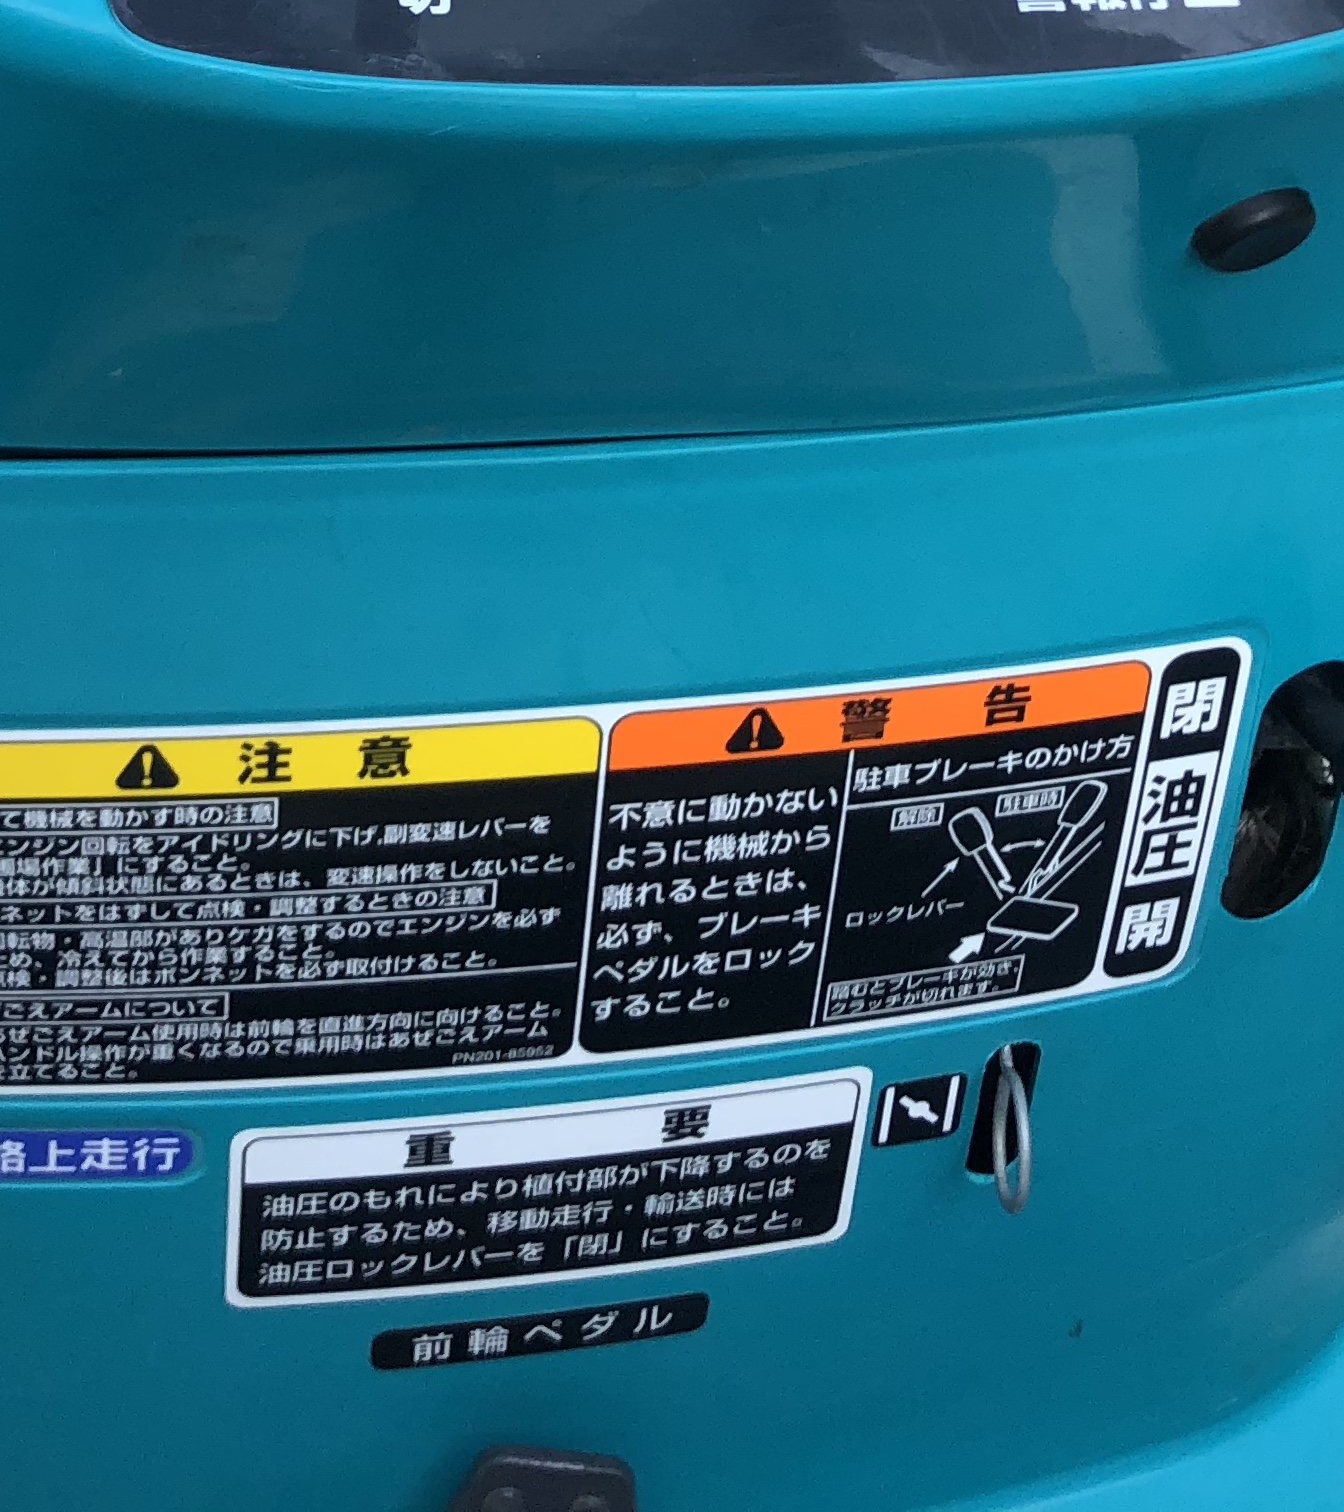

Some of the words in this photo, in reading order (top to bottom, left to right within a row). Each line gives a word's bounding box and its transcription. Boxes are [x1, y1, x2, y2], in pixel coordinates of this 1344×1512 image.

[1160, 676, 1227, 739] 閉
[852, 734, 1136, 792] 駐車ブレーキのかけ方
[609, 787, 839, 832] 不意に動かない
[1131, 769, 1206, 877] 油圧
[606, 824, 830, 871] ように機械から
[600, 867, 807, 911] 離れるときは、
[845, 900, 965, 929] ロックレバー
[1114, 896, 1181, 954] 開
[593, 940, 816, 984] ペダルをロック
[591, 987, 730, 1024] すること。
[262, 1138, 831, 1219] 油圧のもれにより植付部が下降するのを
[412, 1304, 673, 1364] 前輪ペダル
